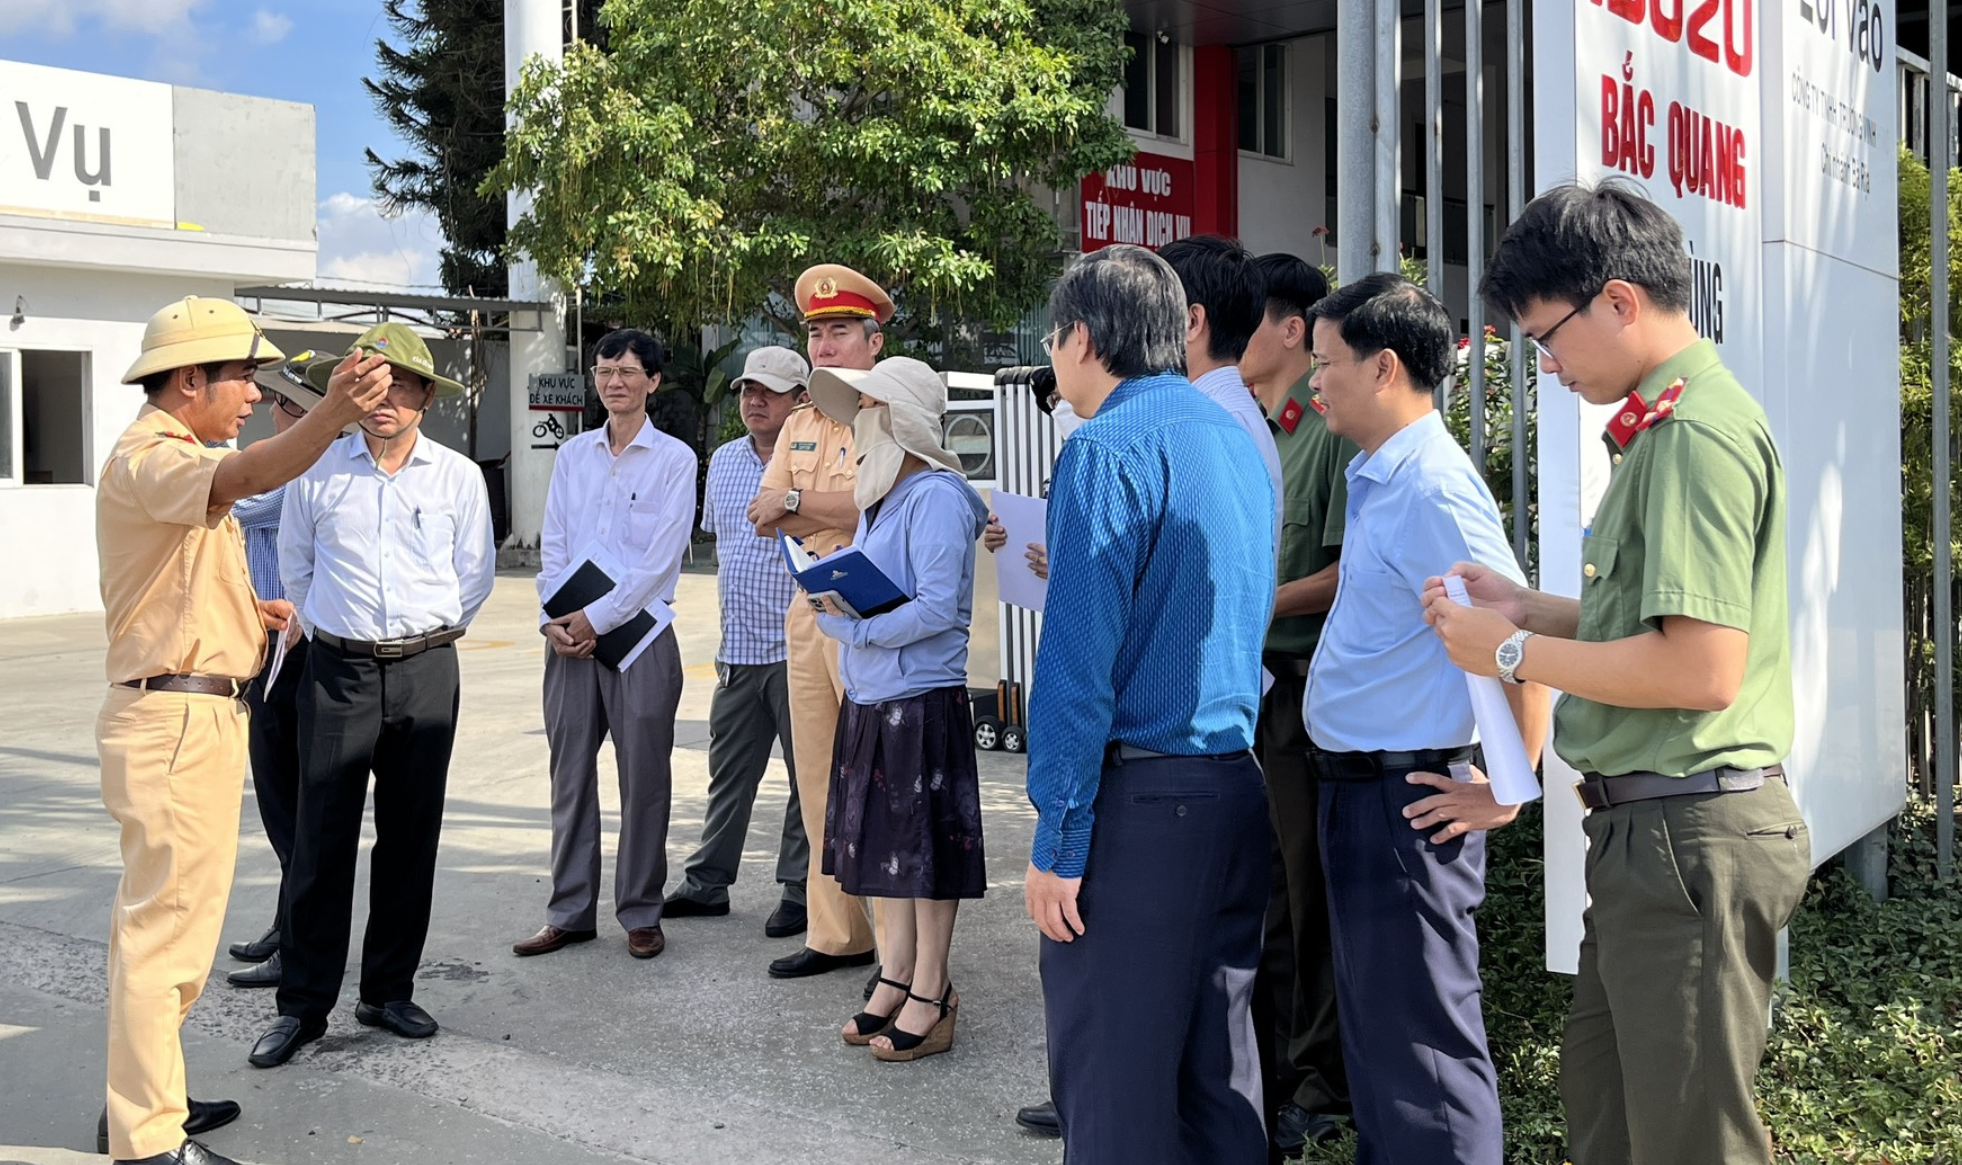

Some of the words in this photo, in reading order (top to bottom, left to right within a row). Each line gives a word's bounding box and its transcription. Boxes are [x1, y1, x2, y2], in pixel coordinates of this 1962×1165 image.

[15, 101, 111, 202] Vụ
[1601, 50, 1655, 179] BẮC
[1667, 101, 1746, 209] QUANG
[1106, 164, 1137, 191] KHU
[1140, 168, 1172, 202] VỰC
[1085, 190, 1111, 241] TIẾP
[1146, 210, 1173, 251] DỊCH
[1689, 240, 1723, 345] ÙNG
[538, 377, 556, 389] KHU
[543, 394, 553, 404] XE
[555, 393, 583, 405] KHÁCH
